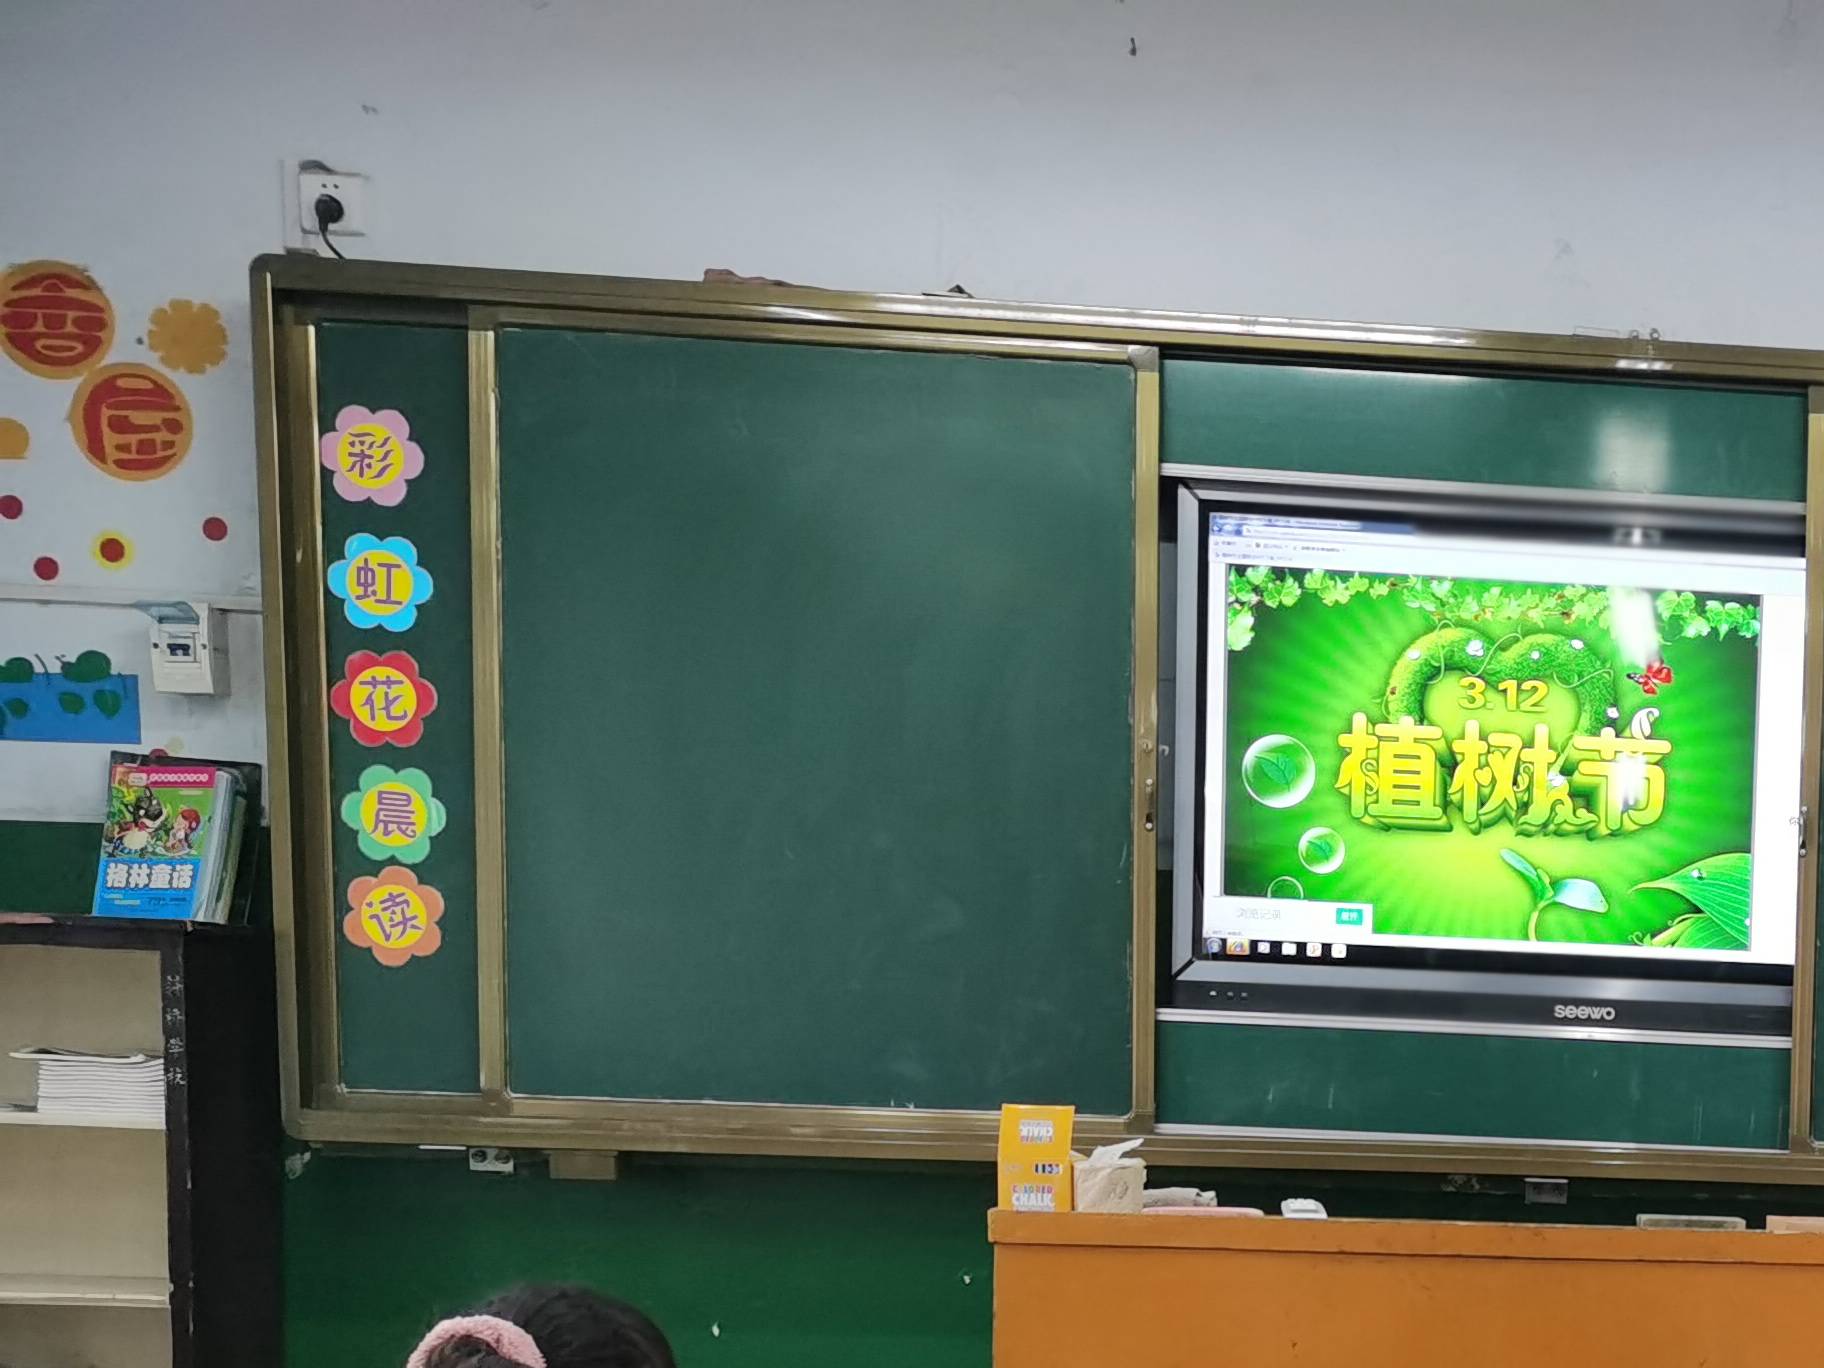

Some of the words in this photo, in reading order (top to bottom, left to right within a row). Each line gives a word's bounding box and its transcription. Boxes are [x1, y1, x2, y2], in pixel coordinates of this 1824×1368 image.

[1335, 711, 1672, 835] 植树节
[105, 861, 195, 890] 格林童话
[1554, 1004, 1616, 1021] seewo
[1012, 1192, 1054, 1206] CHALK
